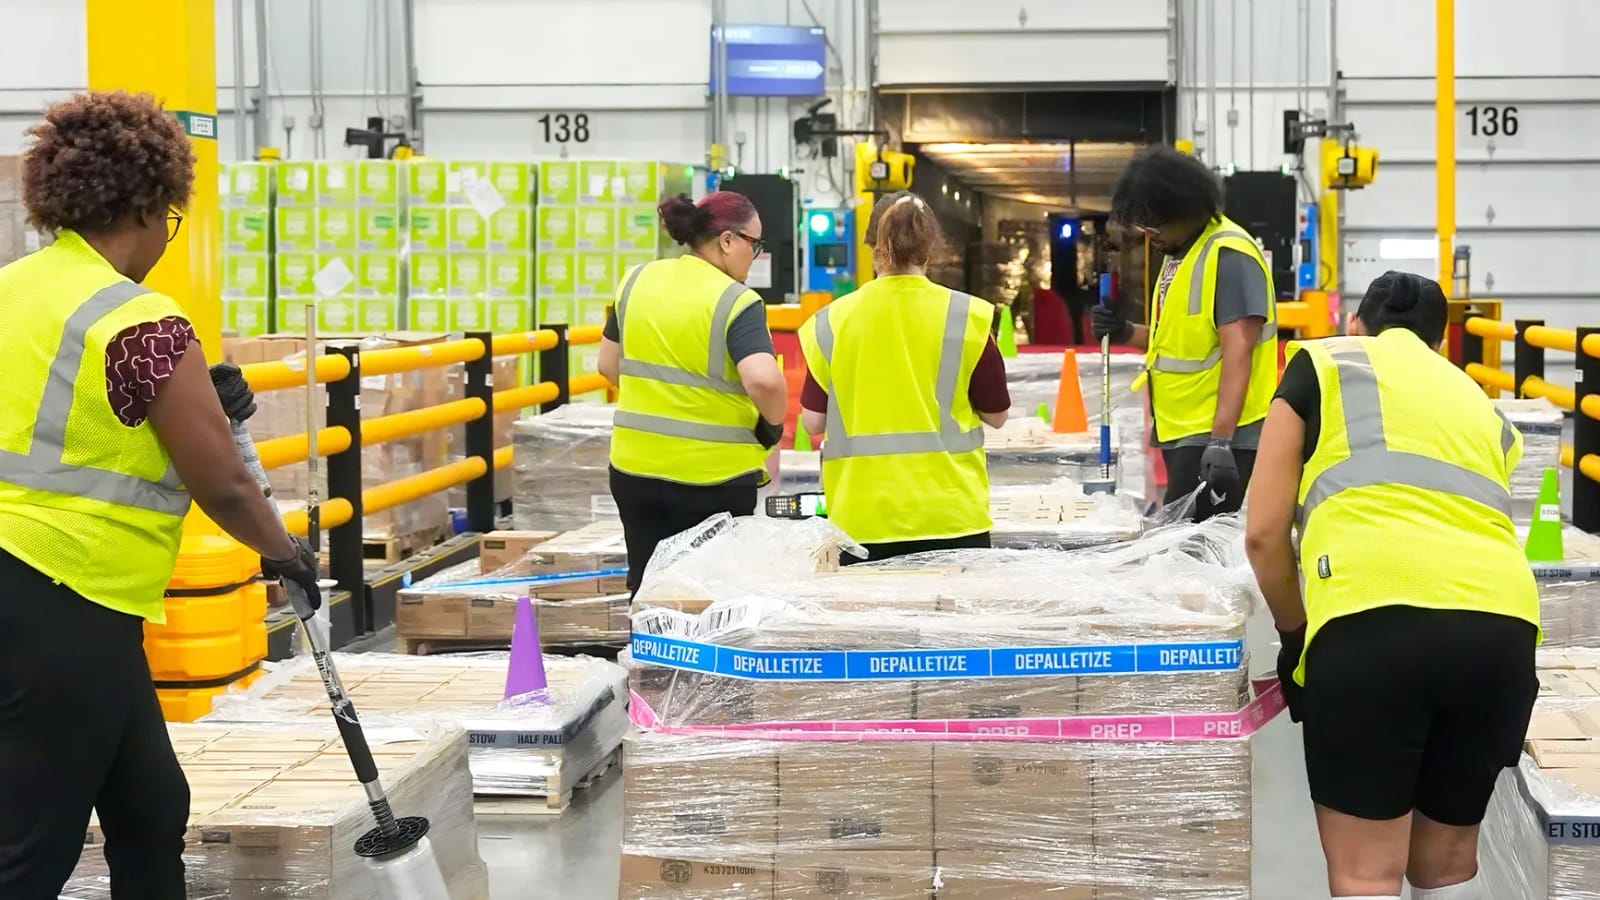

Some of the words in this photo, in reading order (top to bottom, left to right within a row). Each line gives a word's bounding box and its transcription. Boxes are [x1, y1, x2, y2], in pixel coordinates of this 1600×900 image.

[538, 113, 590, 143] 138
[1465, 106, 1519, 136] 136
[633, 638, 700, 664] DEPALLETIZE
[733, 655, 823, 674] DEPALLETIZE
[869, 655, 968, 673] DEPALLETIZE
[1015, 650, 1112, 670] DEPALLETIZE
[1160, 646, 1241, 666] DEPALLETI
[469, 733, 497, 744] STOW
[517, 734, 540, 745] HALF
[1090, 723, 1143, 739] PREP
[1549, 822, 1567, 838] ET
